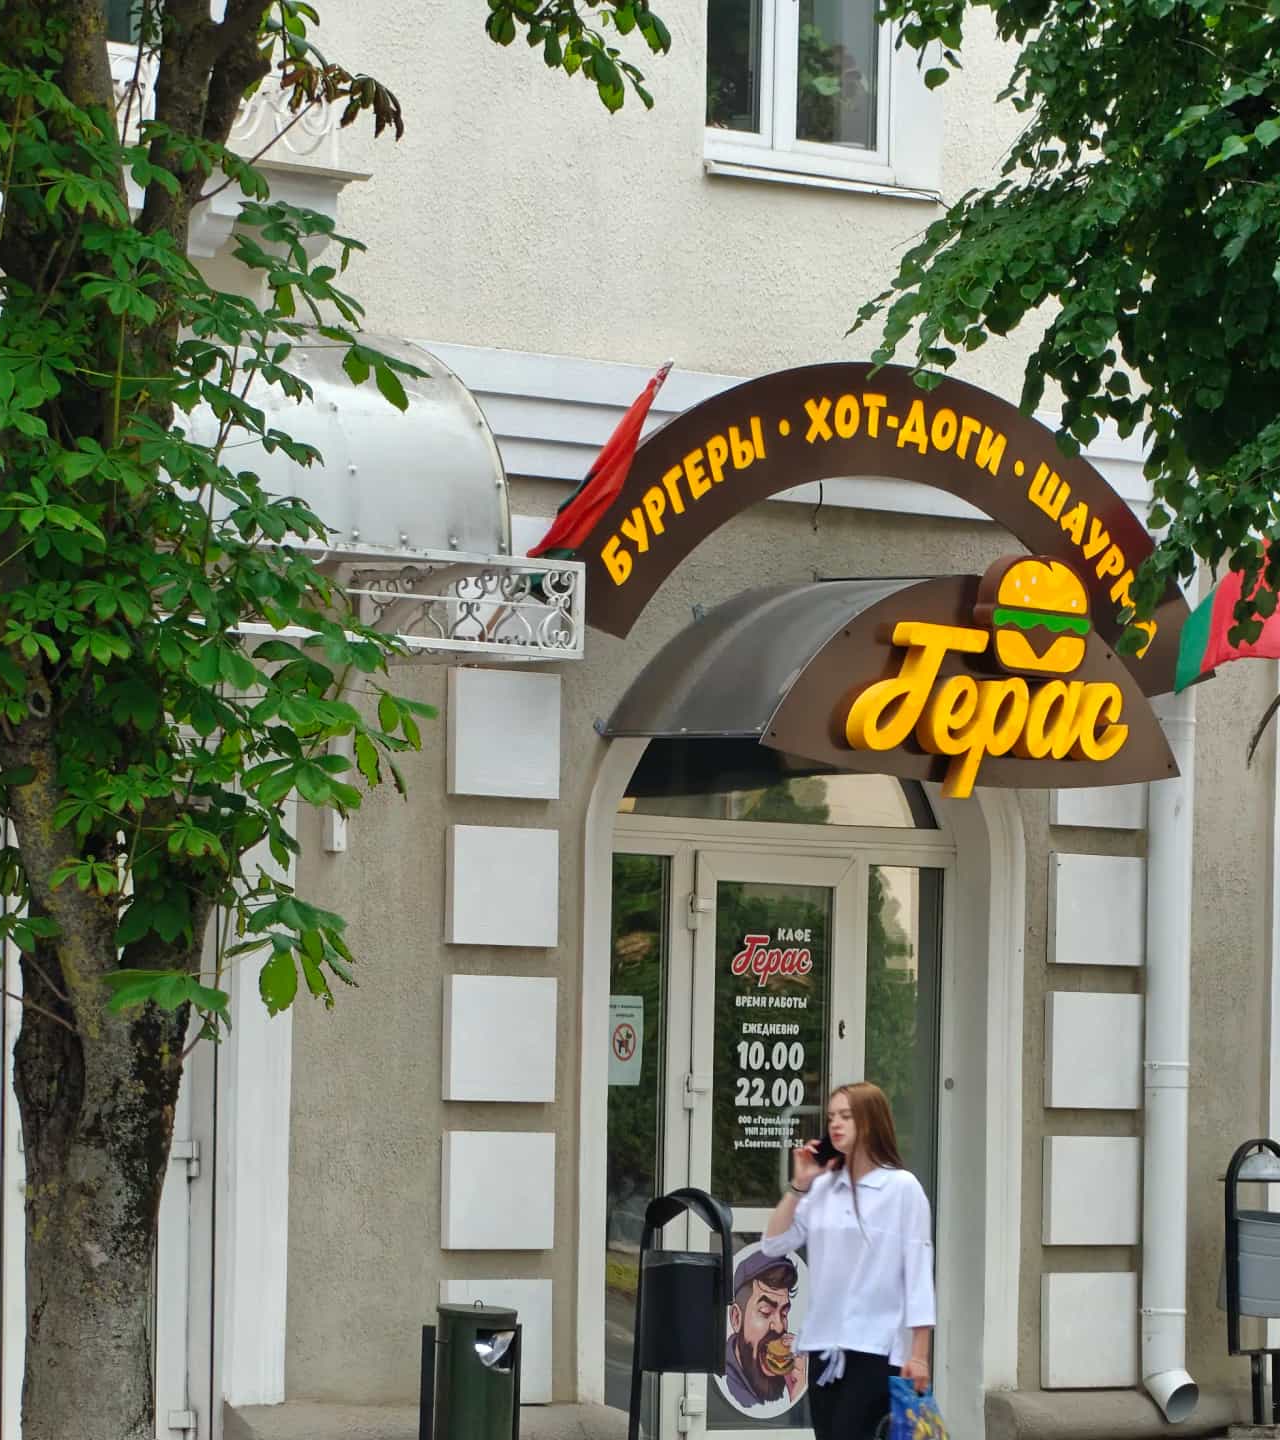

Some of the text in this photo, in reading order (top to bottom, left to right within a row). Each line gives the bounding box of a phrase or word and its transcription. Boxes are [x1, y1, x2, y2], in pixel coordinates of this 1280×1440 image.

[601, 416, 766, 585] БУРГЕРЫ
[805, 393, 1007, 476] ХОТ-ДОГИ
[846, 621, 1128, 797] Герас
[778, 928, 811, 942] КАФЕ
[731, 935, 813, 987] Герас
[736, 996, 807, 1008] ВРЕМЯ РАБОТЫ
[743, 1023, 799, 1036] ЕЖЕДНЕВНО
[737, 1041, 804, 1070] 10.00
[735, 1077, 804, 1107] 22.00
